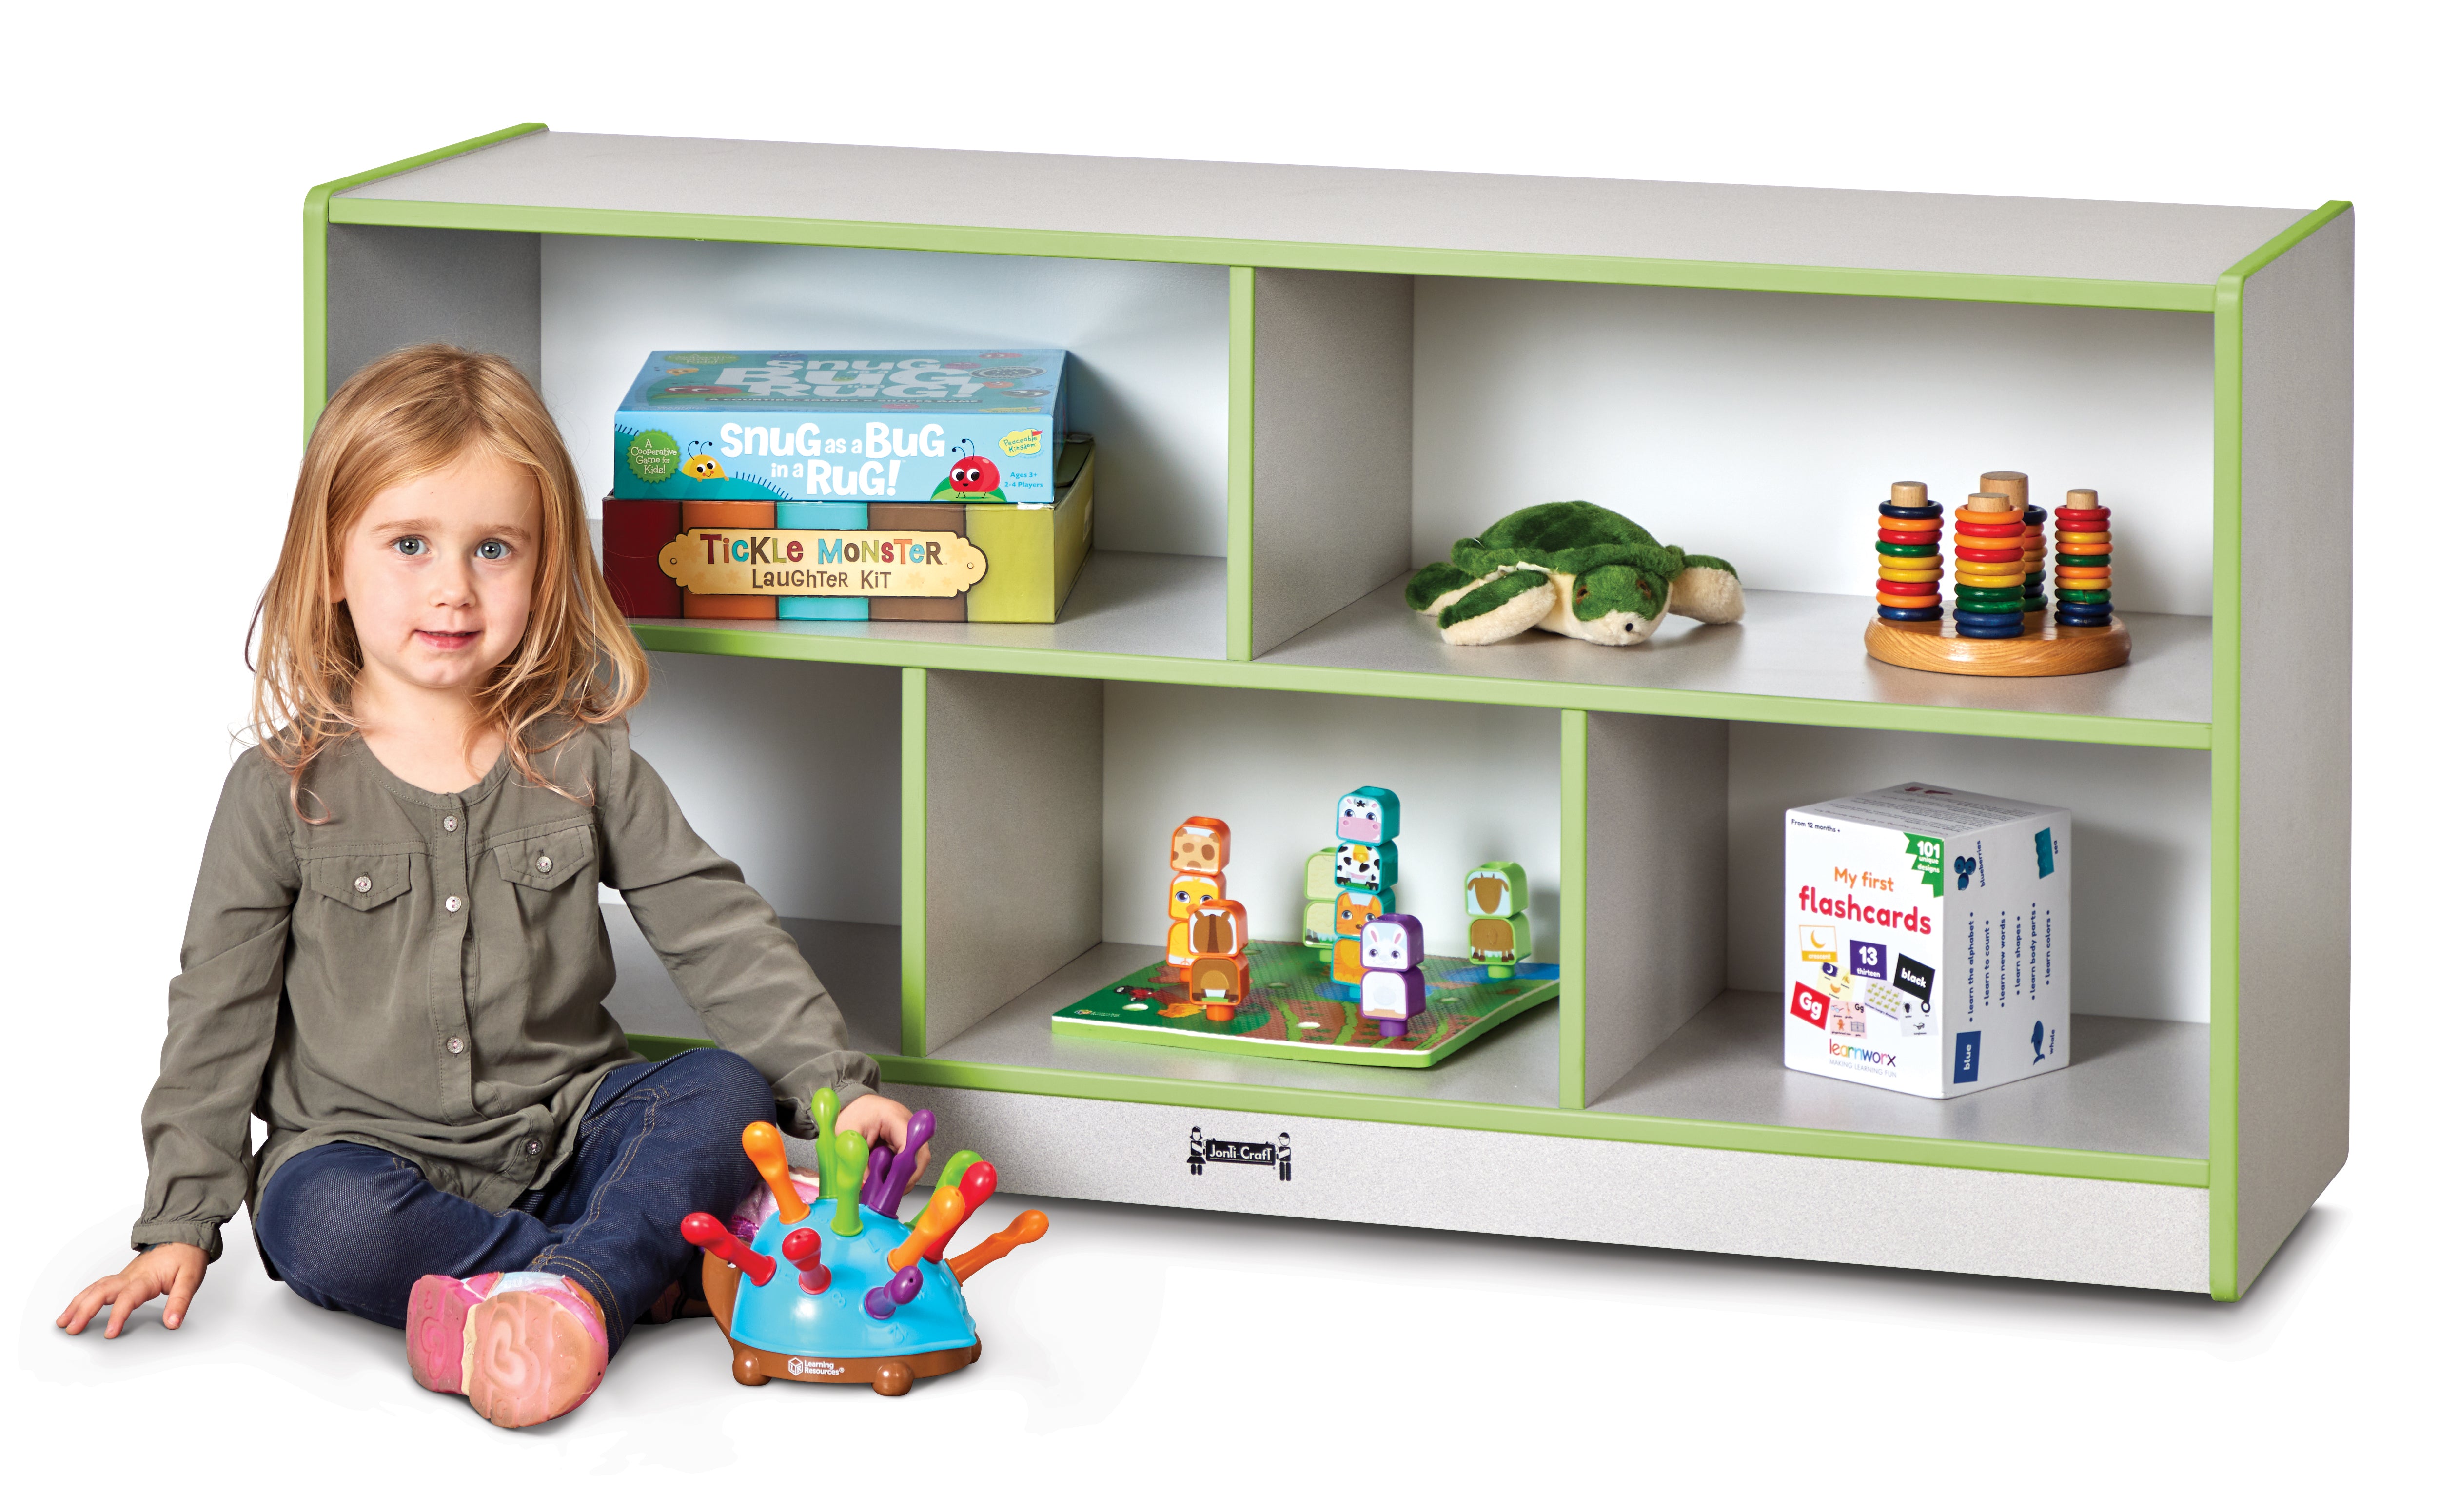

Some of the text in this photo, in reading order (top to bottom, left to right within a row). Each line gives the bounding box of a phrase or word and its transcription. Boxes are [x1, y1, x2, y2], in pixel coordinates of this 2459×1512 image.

[645, 439, 652, 448] A
[824, 438, 846, 454] as
[851, 438, 862, 454] a
[1003, 433, 1037, 446] Peaceable
[631, 447, 677, 456] Cooperative
[1009, 443, 1035, 453] Kingdom
[636, 456, 660, 464] Game
[644, 464, 665, 474] Kids!
[771, 462, 788, 478] in
[792, 463, 804, 478] a
[1791, 819, 1806, 827] From
[1917, 840, 1940, 859] 101
[1919, 856, 1939, 864] unique
[1977, 840, 1985, 887] blueberries
[1917, 863, 1940, 873] designs
[1834, 866, 1894, 892] My first
[1799, 885, 1931, 935] flashcards
[1859, 946, 1878, 966] 13
[1985, 959, 1989, 970] to
[1857, 968, 1880, 978] thirteen
[1901, 968, 1927, 988] black
[1799, 992, 1822, 1020] Gg
[1855, 1003, 1864, 1013] Gg
[1829, 1038, 1896, 1067] learnworx
[1963, 1044, 1971, 1070] blue
[1829, 1059, 1852, 1068] MAKING
[1854, 1063, 1883, 1075] LEARNING
[805, 1360, 834, 1370] Learning
